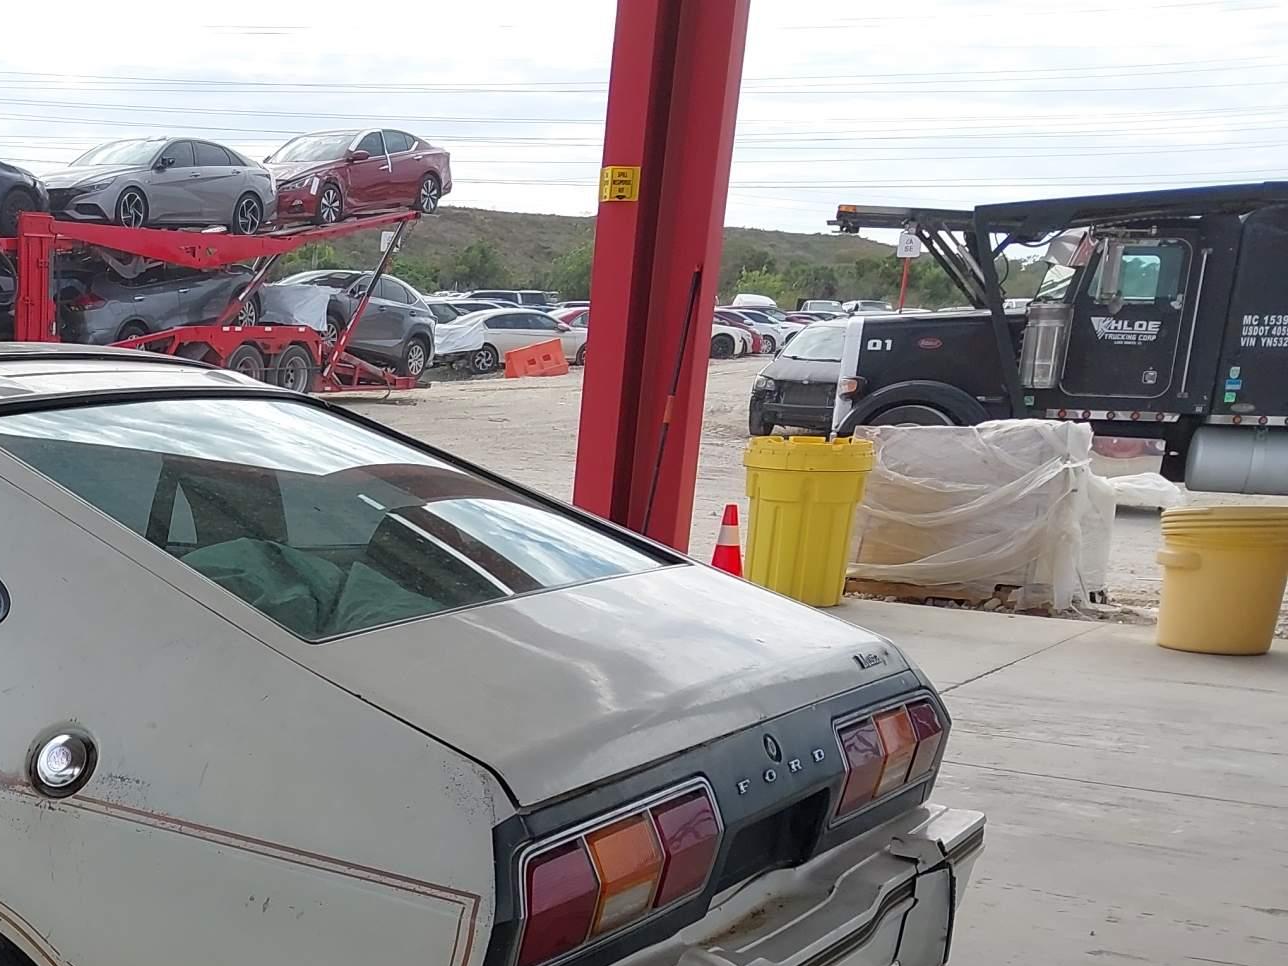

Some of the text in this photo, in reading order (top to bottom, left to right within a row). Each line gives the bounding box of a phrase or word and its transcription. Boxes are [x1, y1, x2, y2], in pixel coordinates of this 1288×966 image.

[1242, 314, 1288, 325] MC 1539
[1241, 325, 1288, 336] USDOT 405
[1104, 333, 1157, 342] TRUCKING CORP
[1240, 336, 1257, 347] VIN
[866, 338, 893, 351] 01
[736, 747, 825, 796] FORD
